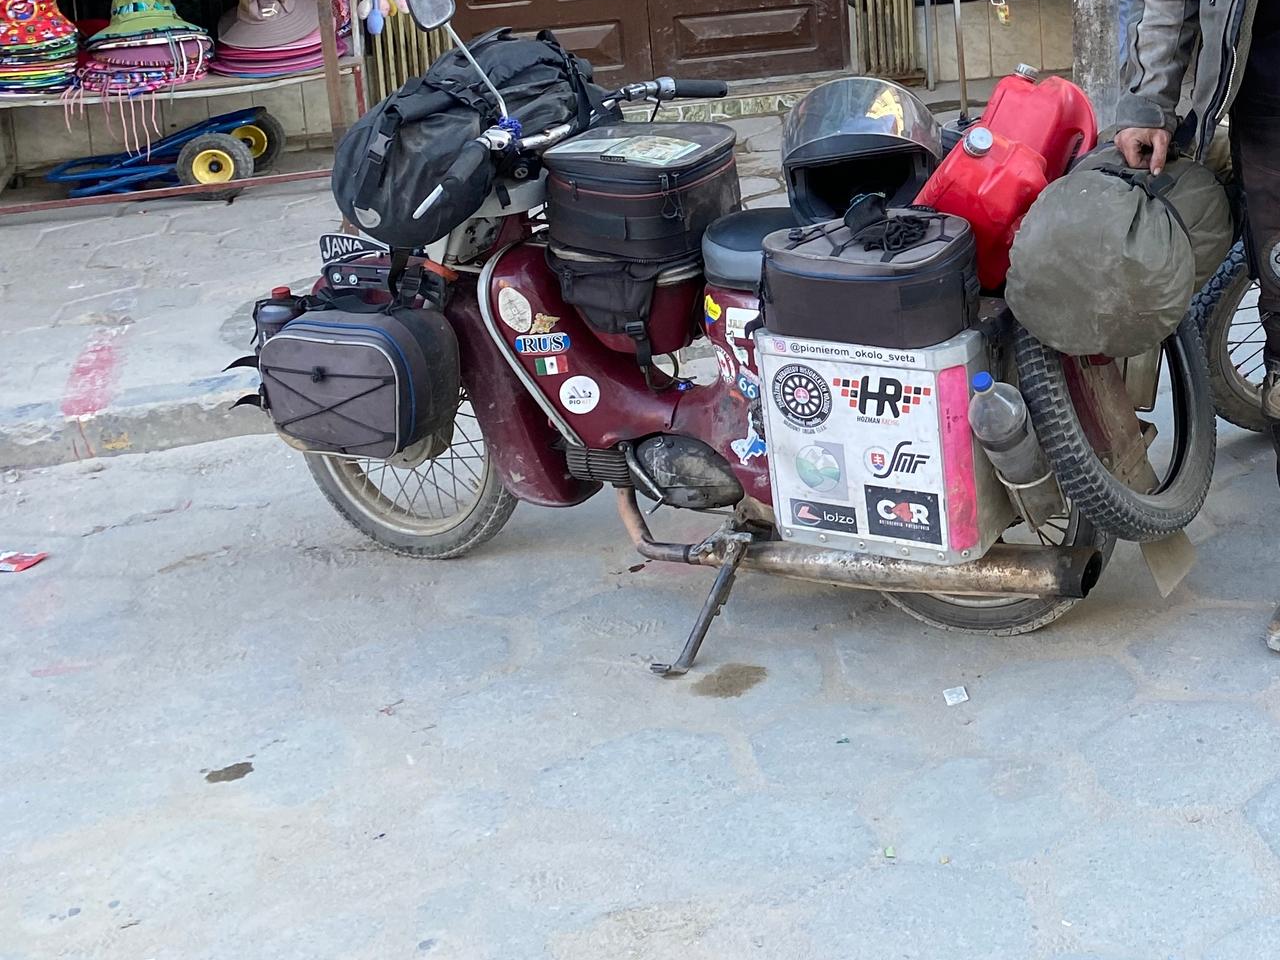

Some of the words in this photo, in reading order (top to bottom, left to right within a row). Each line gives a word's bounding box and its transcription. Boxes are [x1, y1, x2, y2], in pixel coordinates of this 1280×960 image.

[323, 236, 363, 260] JAWA
[521, 335, 565, 353] RUS
[790, 341, 916, 363] @pionierom_okolo_sveta
[739, 377, 756, 399] 66
[858, 375, 903, 419] HR
[823, 511, 855, 525] lojzo
